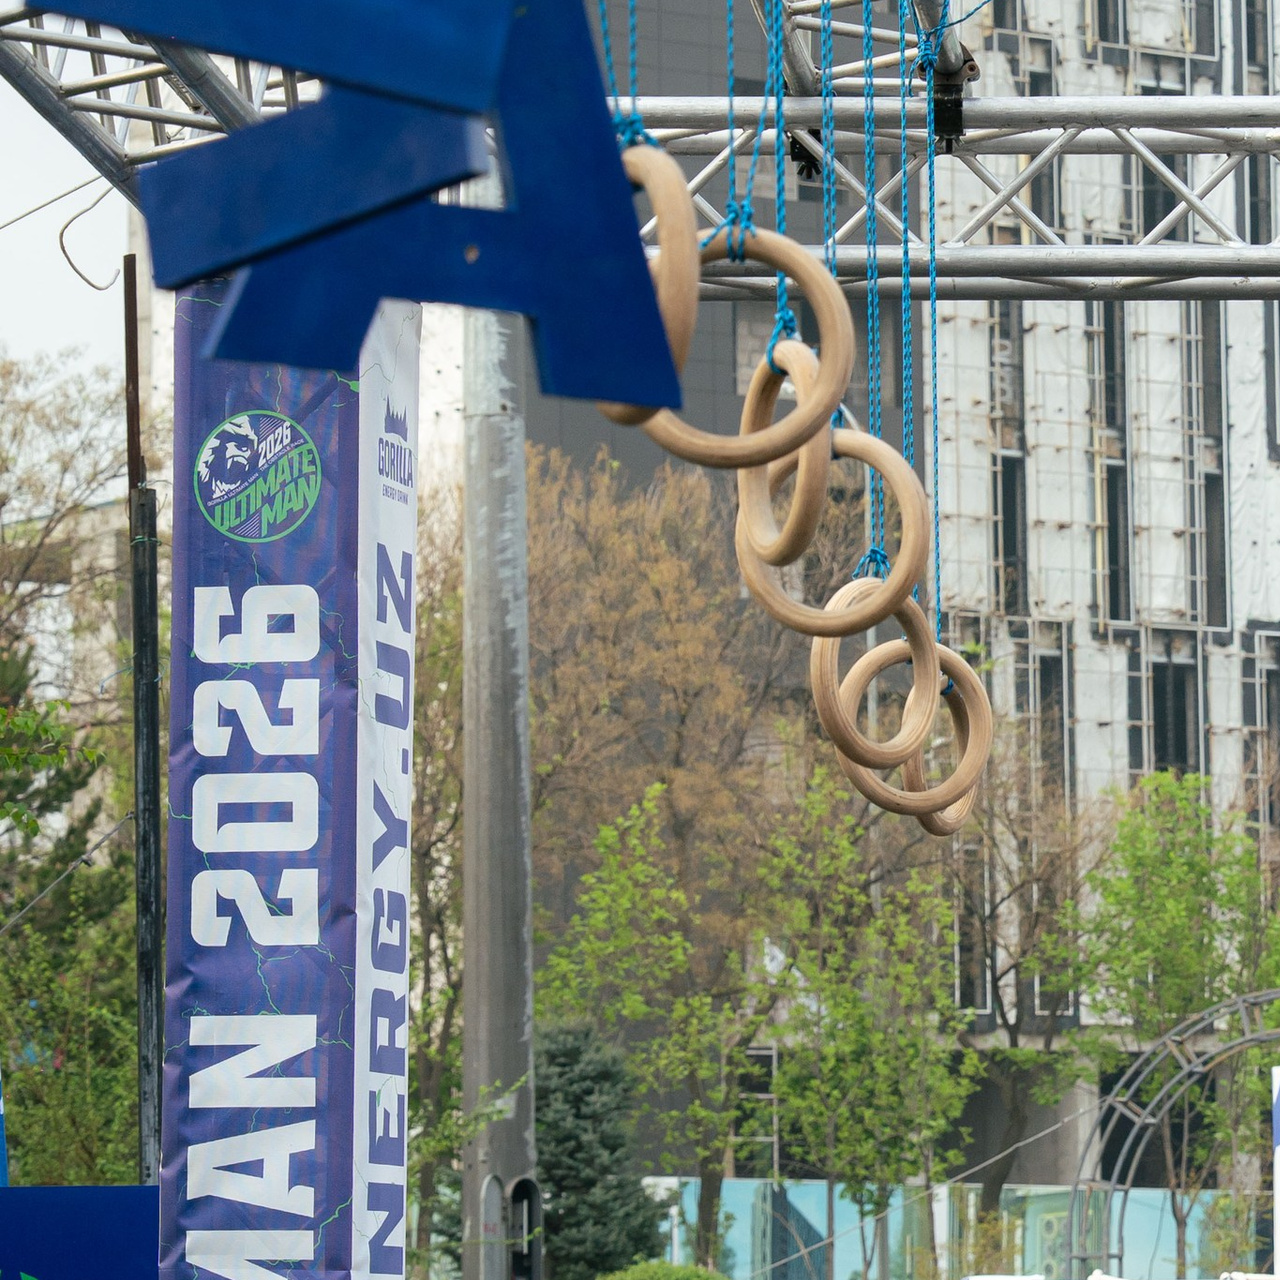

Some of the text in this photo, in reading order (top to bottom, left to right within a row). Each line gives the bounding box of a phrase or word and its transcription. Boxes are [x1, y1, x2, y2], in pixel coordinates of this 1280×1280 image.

[258, 421, 291, 467] 2026
[378, 438, 413, 488] GORILLA
[214, 448, 316, 532] ULTIMATE
[261, 475, 318, 538] MAN
[191, 584, 322, 947] 2026
